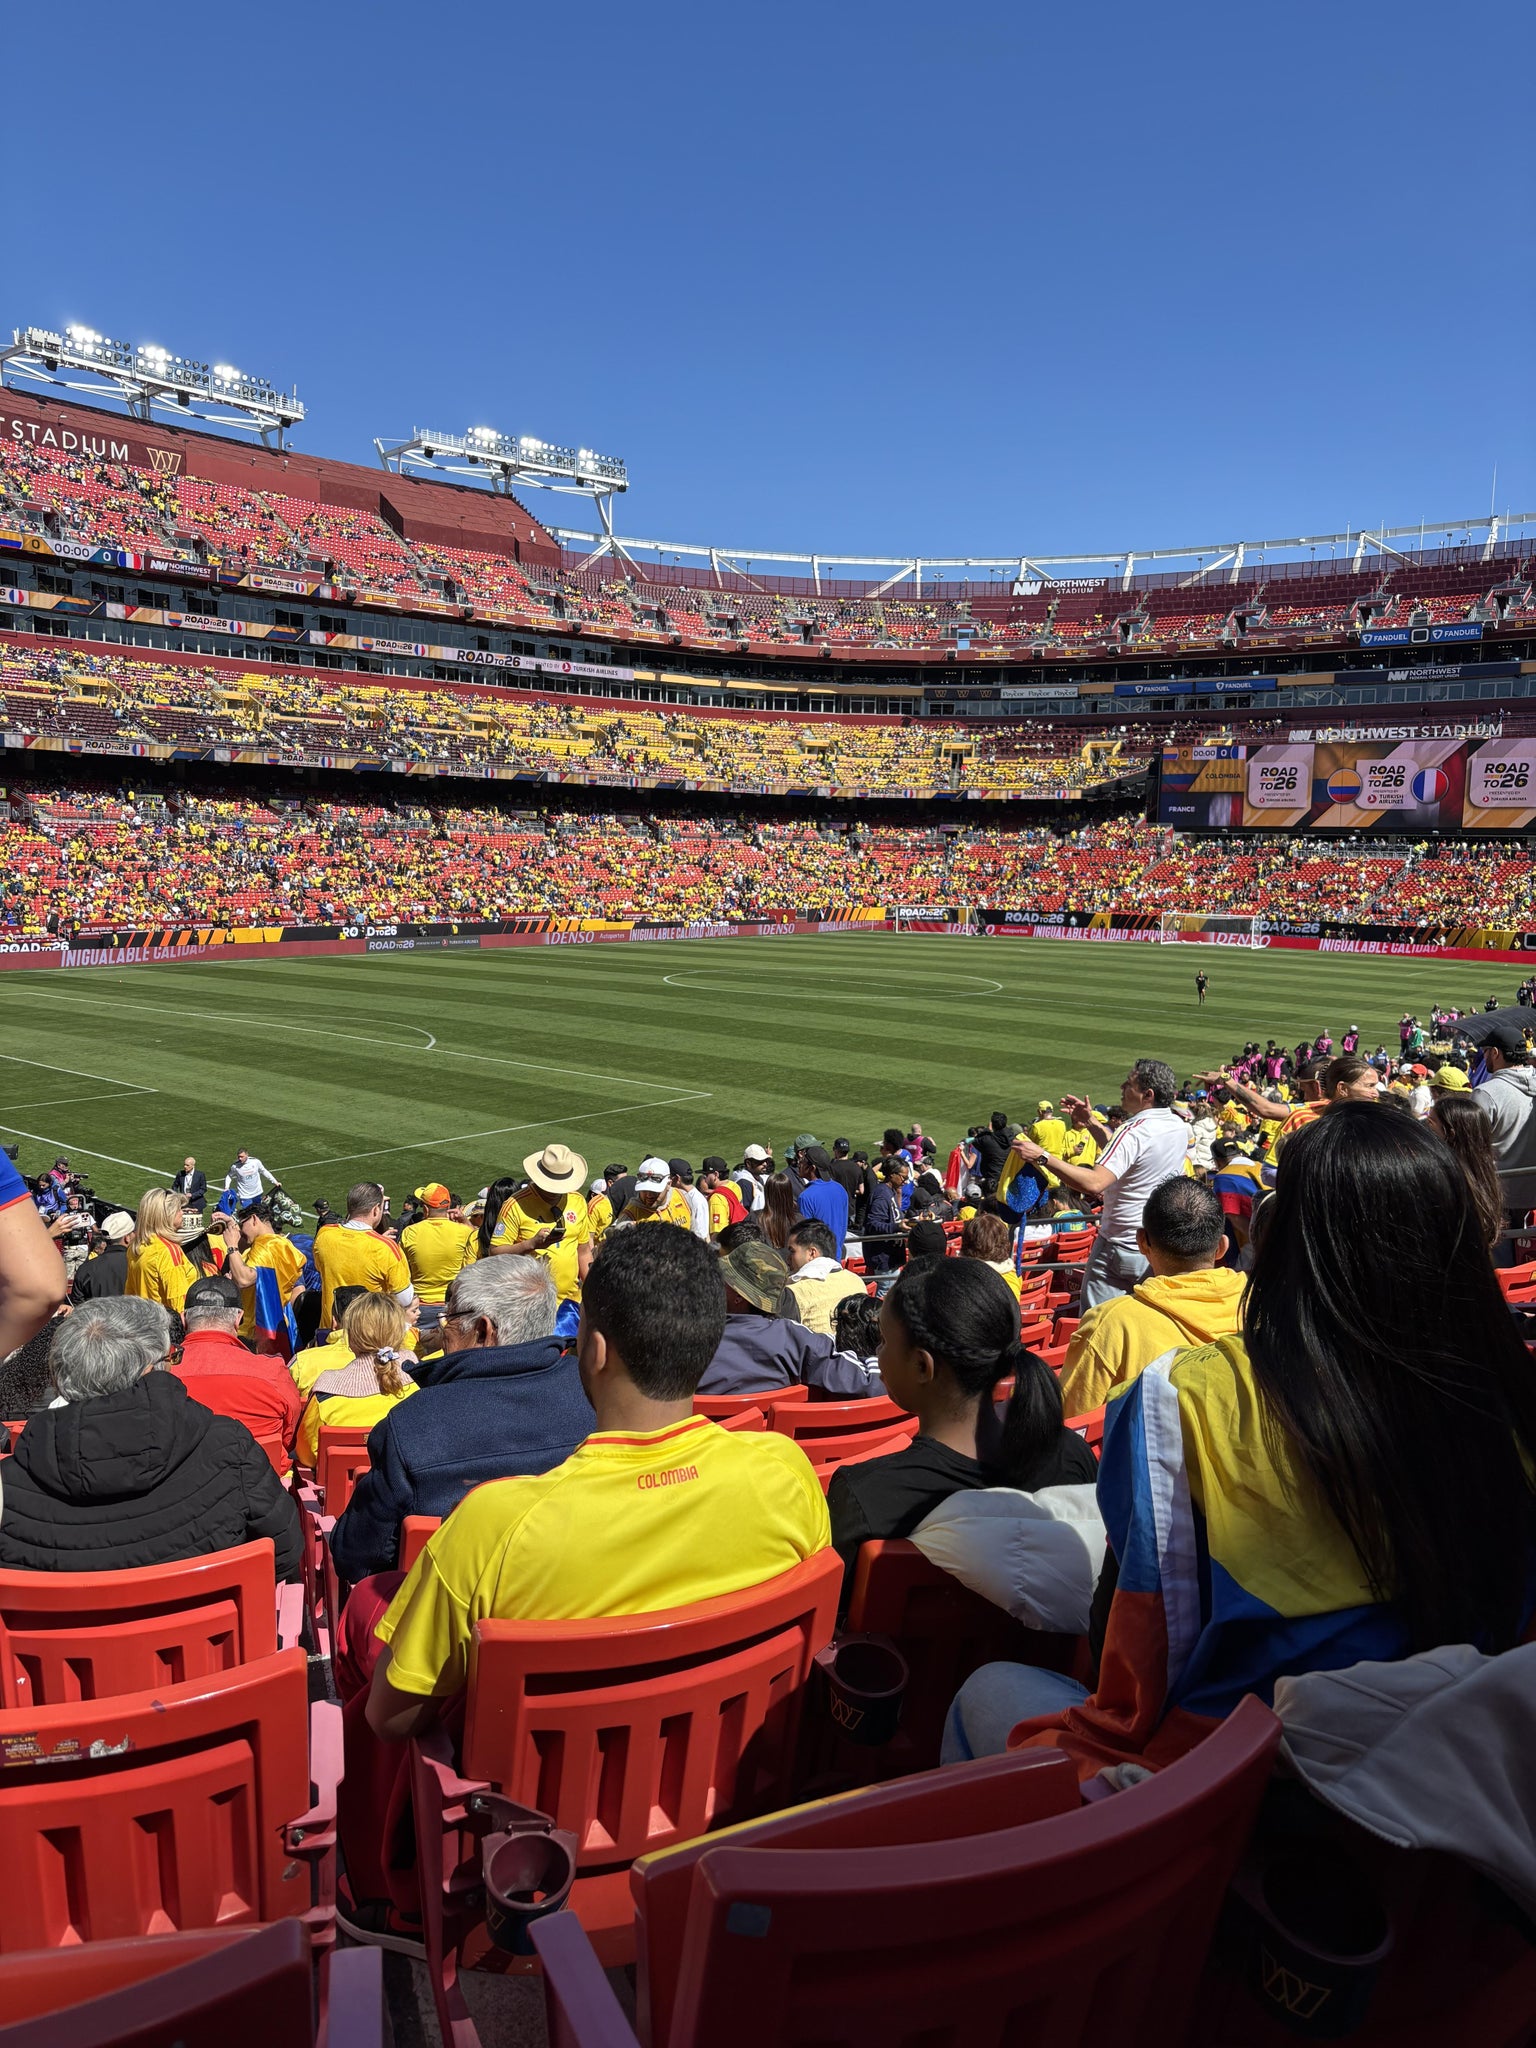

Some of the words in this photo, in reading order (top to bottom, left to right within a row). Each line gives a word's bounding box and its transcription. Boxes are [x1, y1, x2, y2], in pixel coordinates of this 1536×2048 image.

[12, 420, 128, 461] STADIUM
[32, 539, 40, 549] 0
[54, 543, 90, 558] 00:00
[103, 552, 112, 562] 0
[169, 562, 211, 574] NORTHWEST
[264, 578, 281, 586] ROAD
[1044, 578, 1106, 589] NORTHWEST
[1012, 581, 1042, 596] NW
[185, 615, 209, 625] ROAD
[1374, 634, 1408, 642] FANDUEL
[1444, 628, 1480, 637] FANDUEL
[376, 640, 396, 648] ROAD
[457, 650, 494, 663] ROAD
[505, 656, 521, 666] 26
[596, 668, 618, 676] AIRLINES
[1388, 671, 1409, 681] NW
[1410, 667, 1461, 676] NORTHWEST
[1003, 690, 1024, 698] Paycor
[1028, 689, 1050, 698] Paycor
[1054, 689, 1076, 697] Paycor
[1288, 730, 1312, 742] NW
[1316, 727, 1418, 741] NORTHWEST
[1422, 724, 1503, 737] STADIUM
[85, 741, 110, 749] ROAD
[282, 754, 303, 762] ROAD
[1260, 767, 1298, 777] ROAD
[1369, 765, 1406, 775] ROAD
[1484, 762, 1530, 774] ROAD
[1260, 782, 1273, 790] TO
[1484, 780, 1499, 788] TO
[900, 908, 926, 916] ROAD
[1005, 912, 1040, 923] ROAD
[1048, 914, 1065, 923] 26
[342, 926, 375, 937] ROD
[384, 925, 397, 936] 26
[762, 923, 794, 935] DENSO
[952, 923, 995, 936] DENO
[1250, 921, 1290, 932] ROAD
[1301, 923, 1320, 933] 26
[551, 931, 595, 944] DENSO
[630, 927, 674, 941] INIGUALABLE
[676, 926, 704, 940] CALIDAD
[705, 925, 738, 937] JAPONESA
[1032, 925, 1088, 939] INIGUALABLE
[1090, 927, 1128, 941] CALIDAD
[369, 941, 396, 950] ROAD
[403, 940, 414, 948] 26
[1217, 932, 1271, 947] DENSO
[0, 943, 40, 952] ROAD
[52, 941, 70, 951] 26
[1319, 938, 1388, 953] INIGUALABLE
[61, 946, 150, 967] INIGUALABLE
[637, 1465, 699, 1490] COLOMBIA
